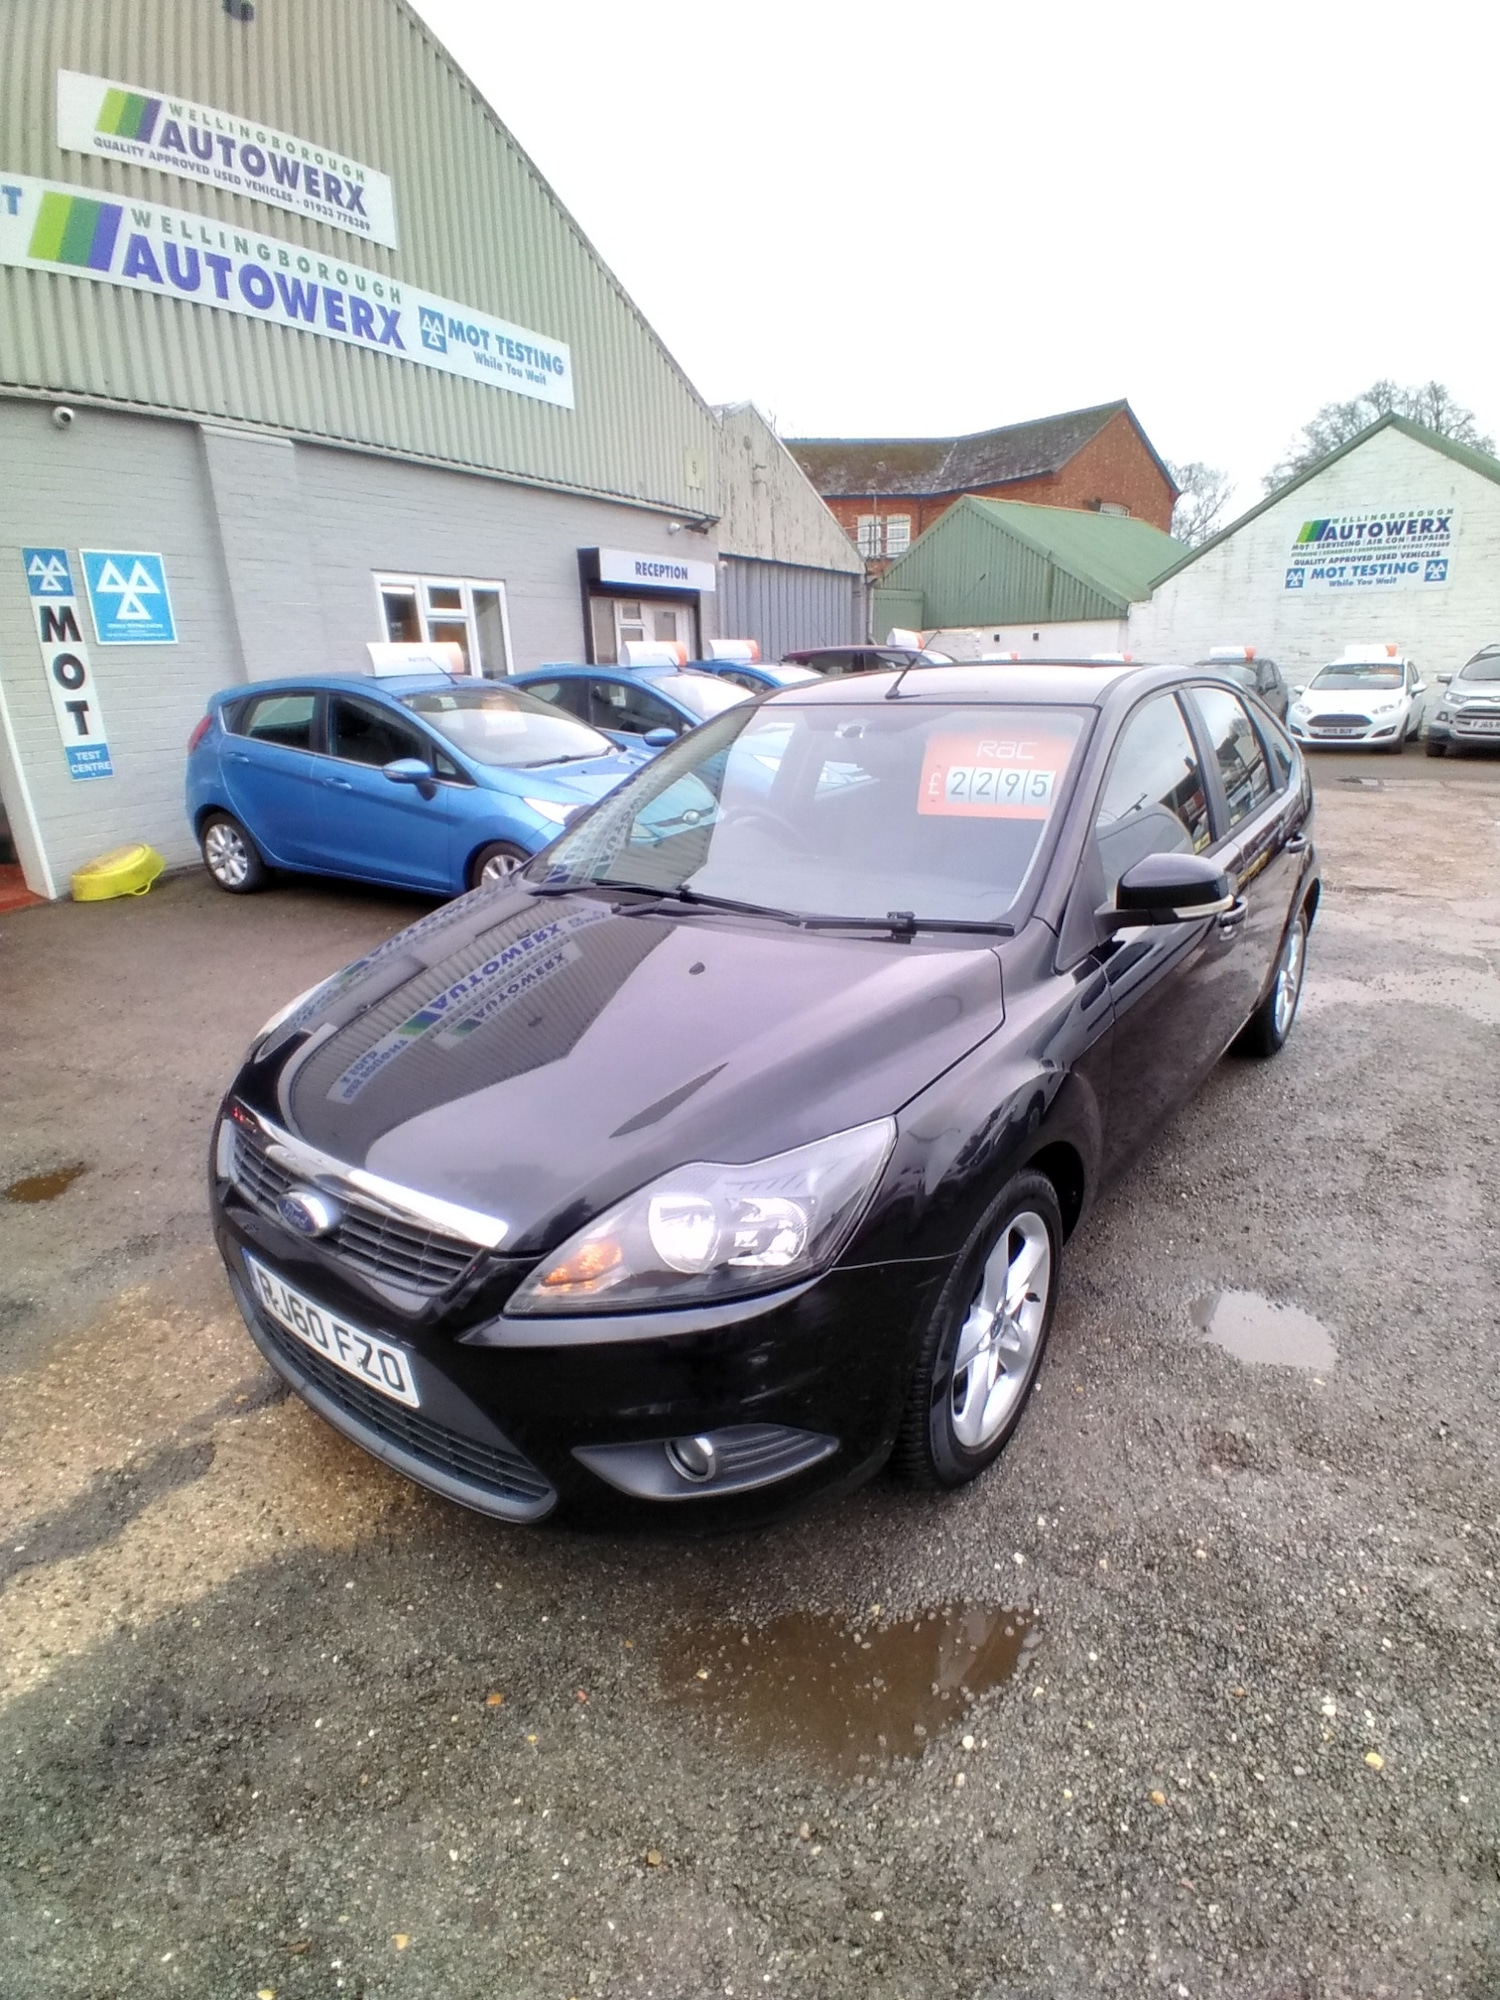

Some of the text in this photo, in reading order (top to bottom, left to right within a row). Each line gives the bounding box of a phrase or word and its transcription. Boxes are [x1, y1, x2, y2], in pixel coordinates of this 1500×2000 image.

[168, 102, 365, 183] WELLINGBOROUGH
[159, 118, 368, 217] AUTOWERX
[93, 137, 144, 157] QUALITY
[149, 151, 210, 175] APPROVED
[213, 169, 242, 186] USED
[244, 178, 293, 203] VEHICLES
[303, 200, 334, 218] 01933
[336, 210, 371, 231] 778389
[131, 207, 401, 305] WELLINGBOROUGH
[122, 232, 406, 351] AUTOWERX
[448, 317, 565, 376] MOT TESTING
[473, 350, 547, 386] While You Wait
[1323, 516, 1452, 541] AUTOWERX
[1332, 508, 1454, 524] WELLINGBOROUGH
[1291, 533, 1451, 551] MOT SERVICING AIR CON REPAIRS
[635, 561, 688, 580] RECEPTION
[1293, 550, 1441, 566] QUALITY APPROVED USED VEHICLES
[1310, 561, 1420, 579] MOT TESTING
[1328, 577, 1397, 587] While You Wait
[39, 605, 90, 736] MOT
[71, 761, 112, 771] CENTRE
[75, 751, 101, 760] TEST
[256, 1267, 330, 1350] RJ60
